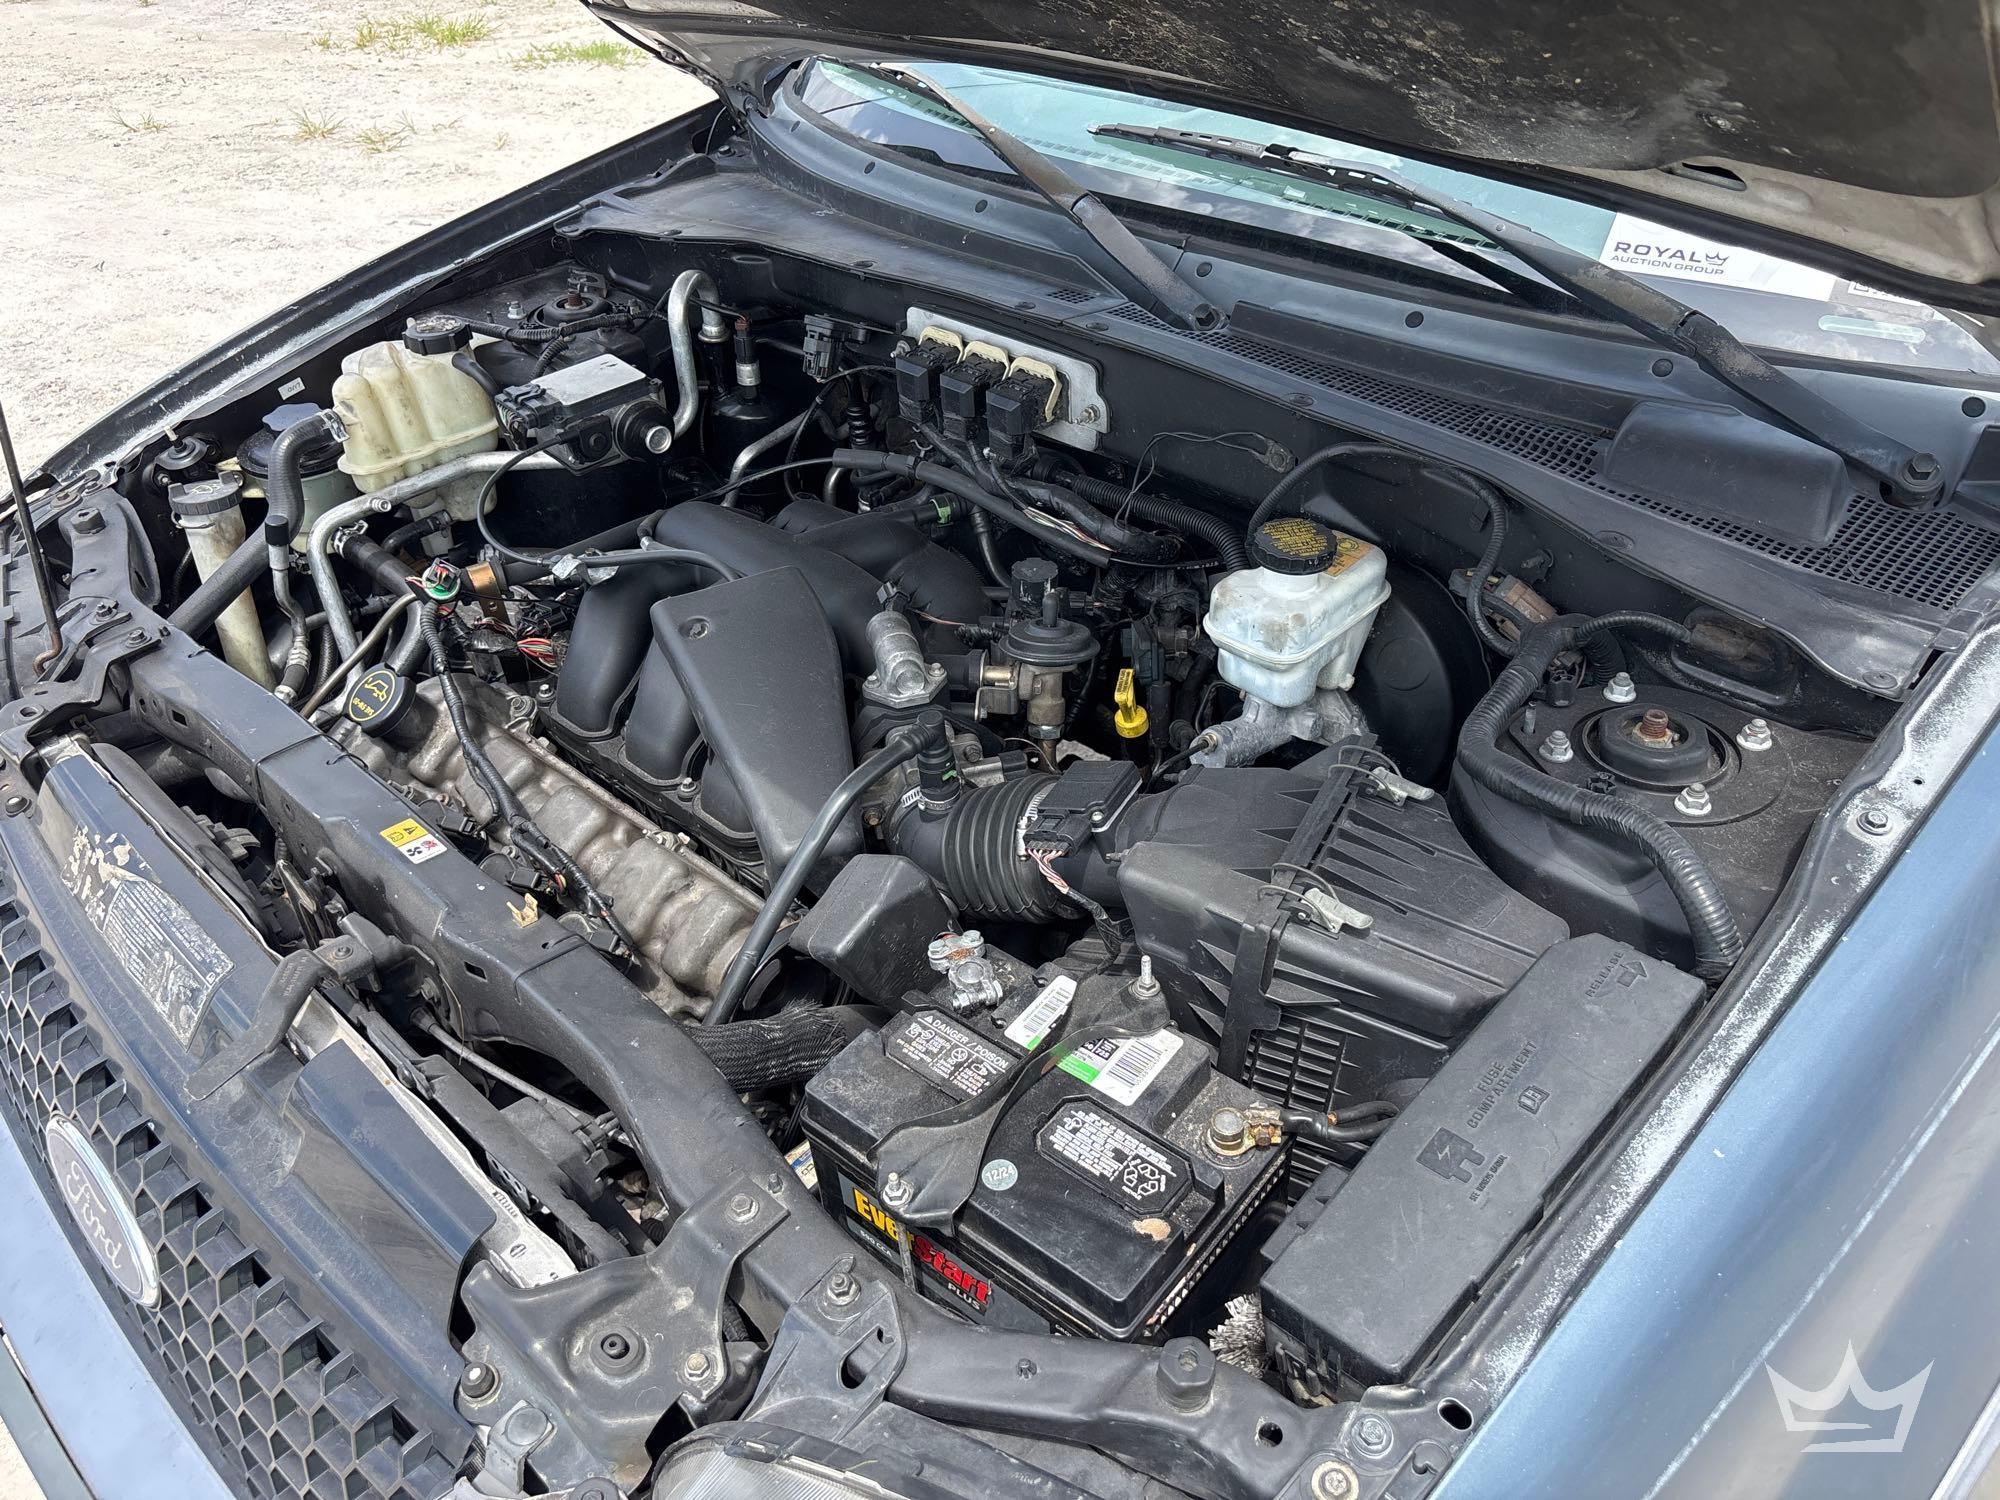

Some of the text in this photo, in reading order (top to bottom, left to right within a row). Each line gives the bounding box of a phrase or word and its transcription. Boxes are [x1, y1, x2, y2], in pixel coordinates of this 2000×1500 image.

[1610, 255, 1724, 275] AUCTION GROUP
[1614, 241, 1700, 263] ROYAL
[932, 1019, 969, 1044] DANGER
[974, 1044, 1009, 1069] POISON
[1466, 1041, 1537, 1128] COMPARTMENT
[1477, 1061, 1505, 1092] FUSE
[66, 1160, 122, 1269] Ford
[947, 1283, 981, 1311] PLUS
